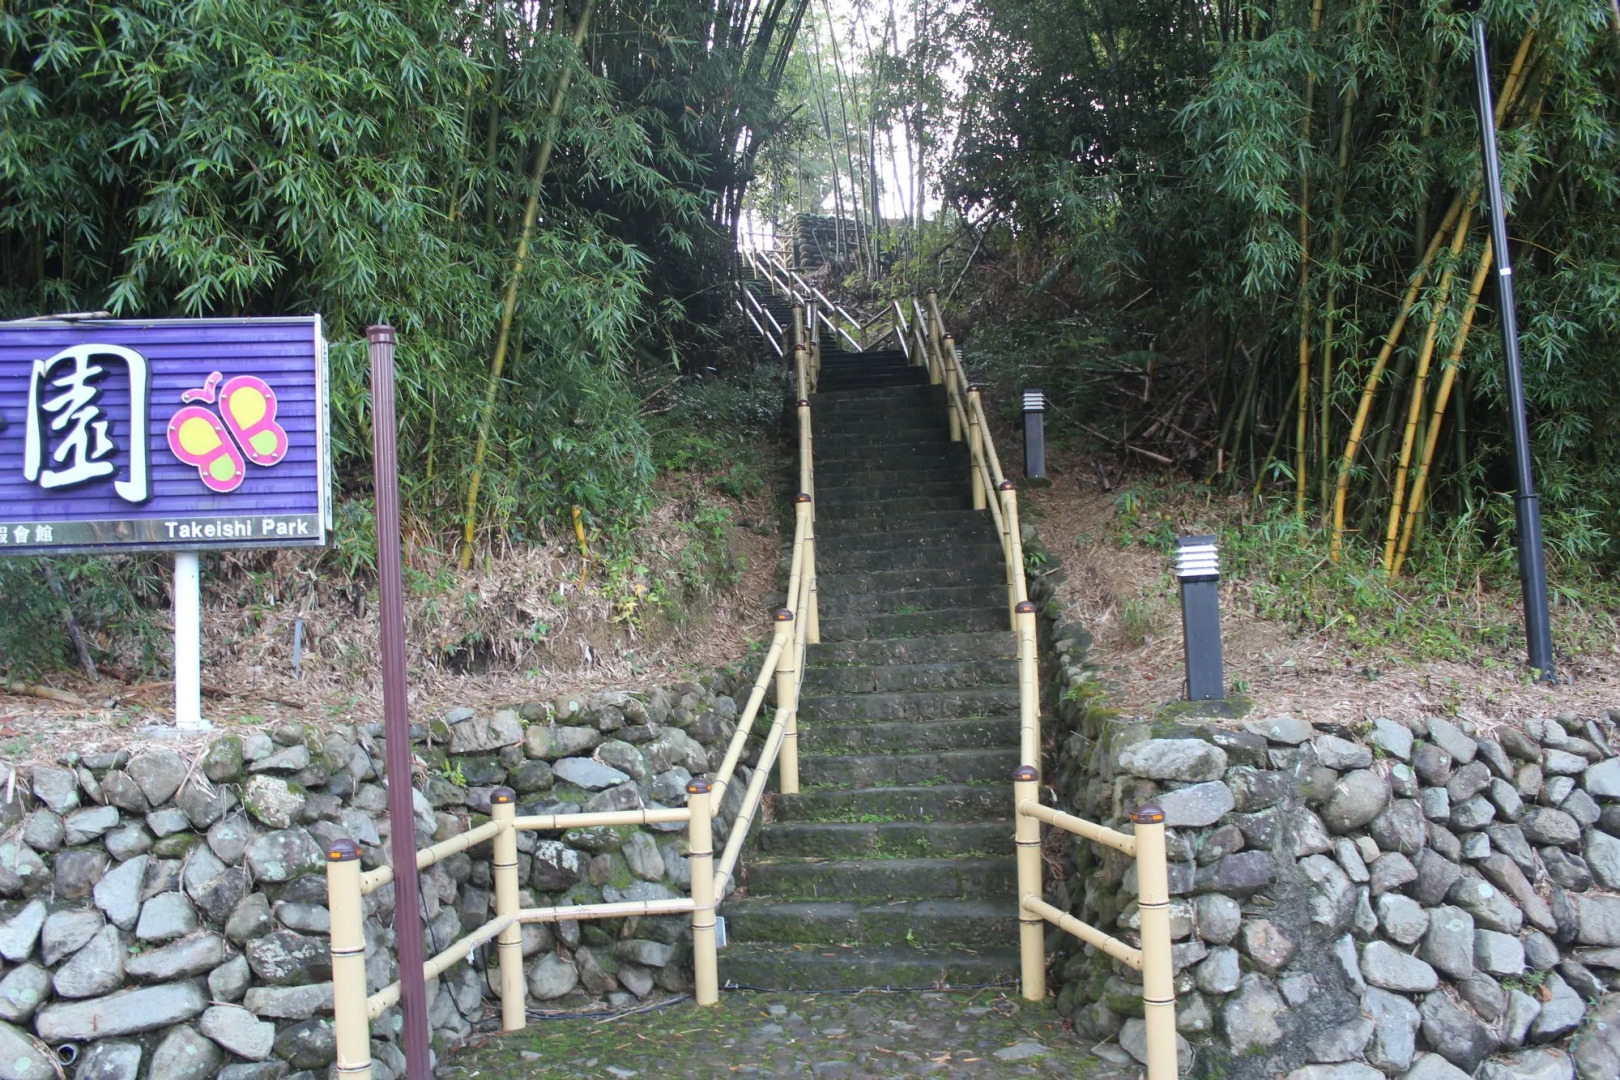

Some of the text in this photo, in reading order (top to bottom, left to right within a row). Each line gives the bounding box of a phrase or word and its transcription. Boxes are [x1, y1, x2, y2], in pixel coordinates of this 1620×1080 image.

[23, 343, 148, 503] 園
[165, 518, 308, 538] Takeishi Park
